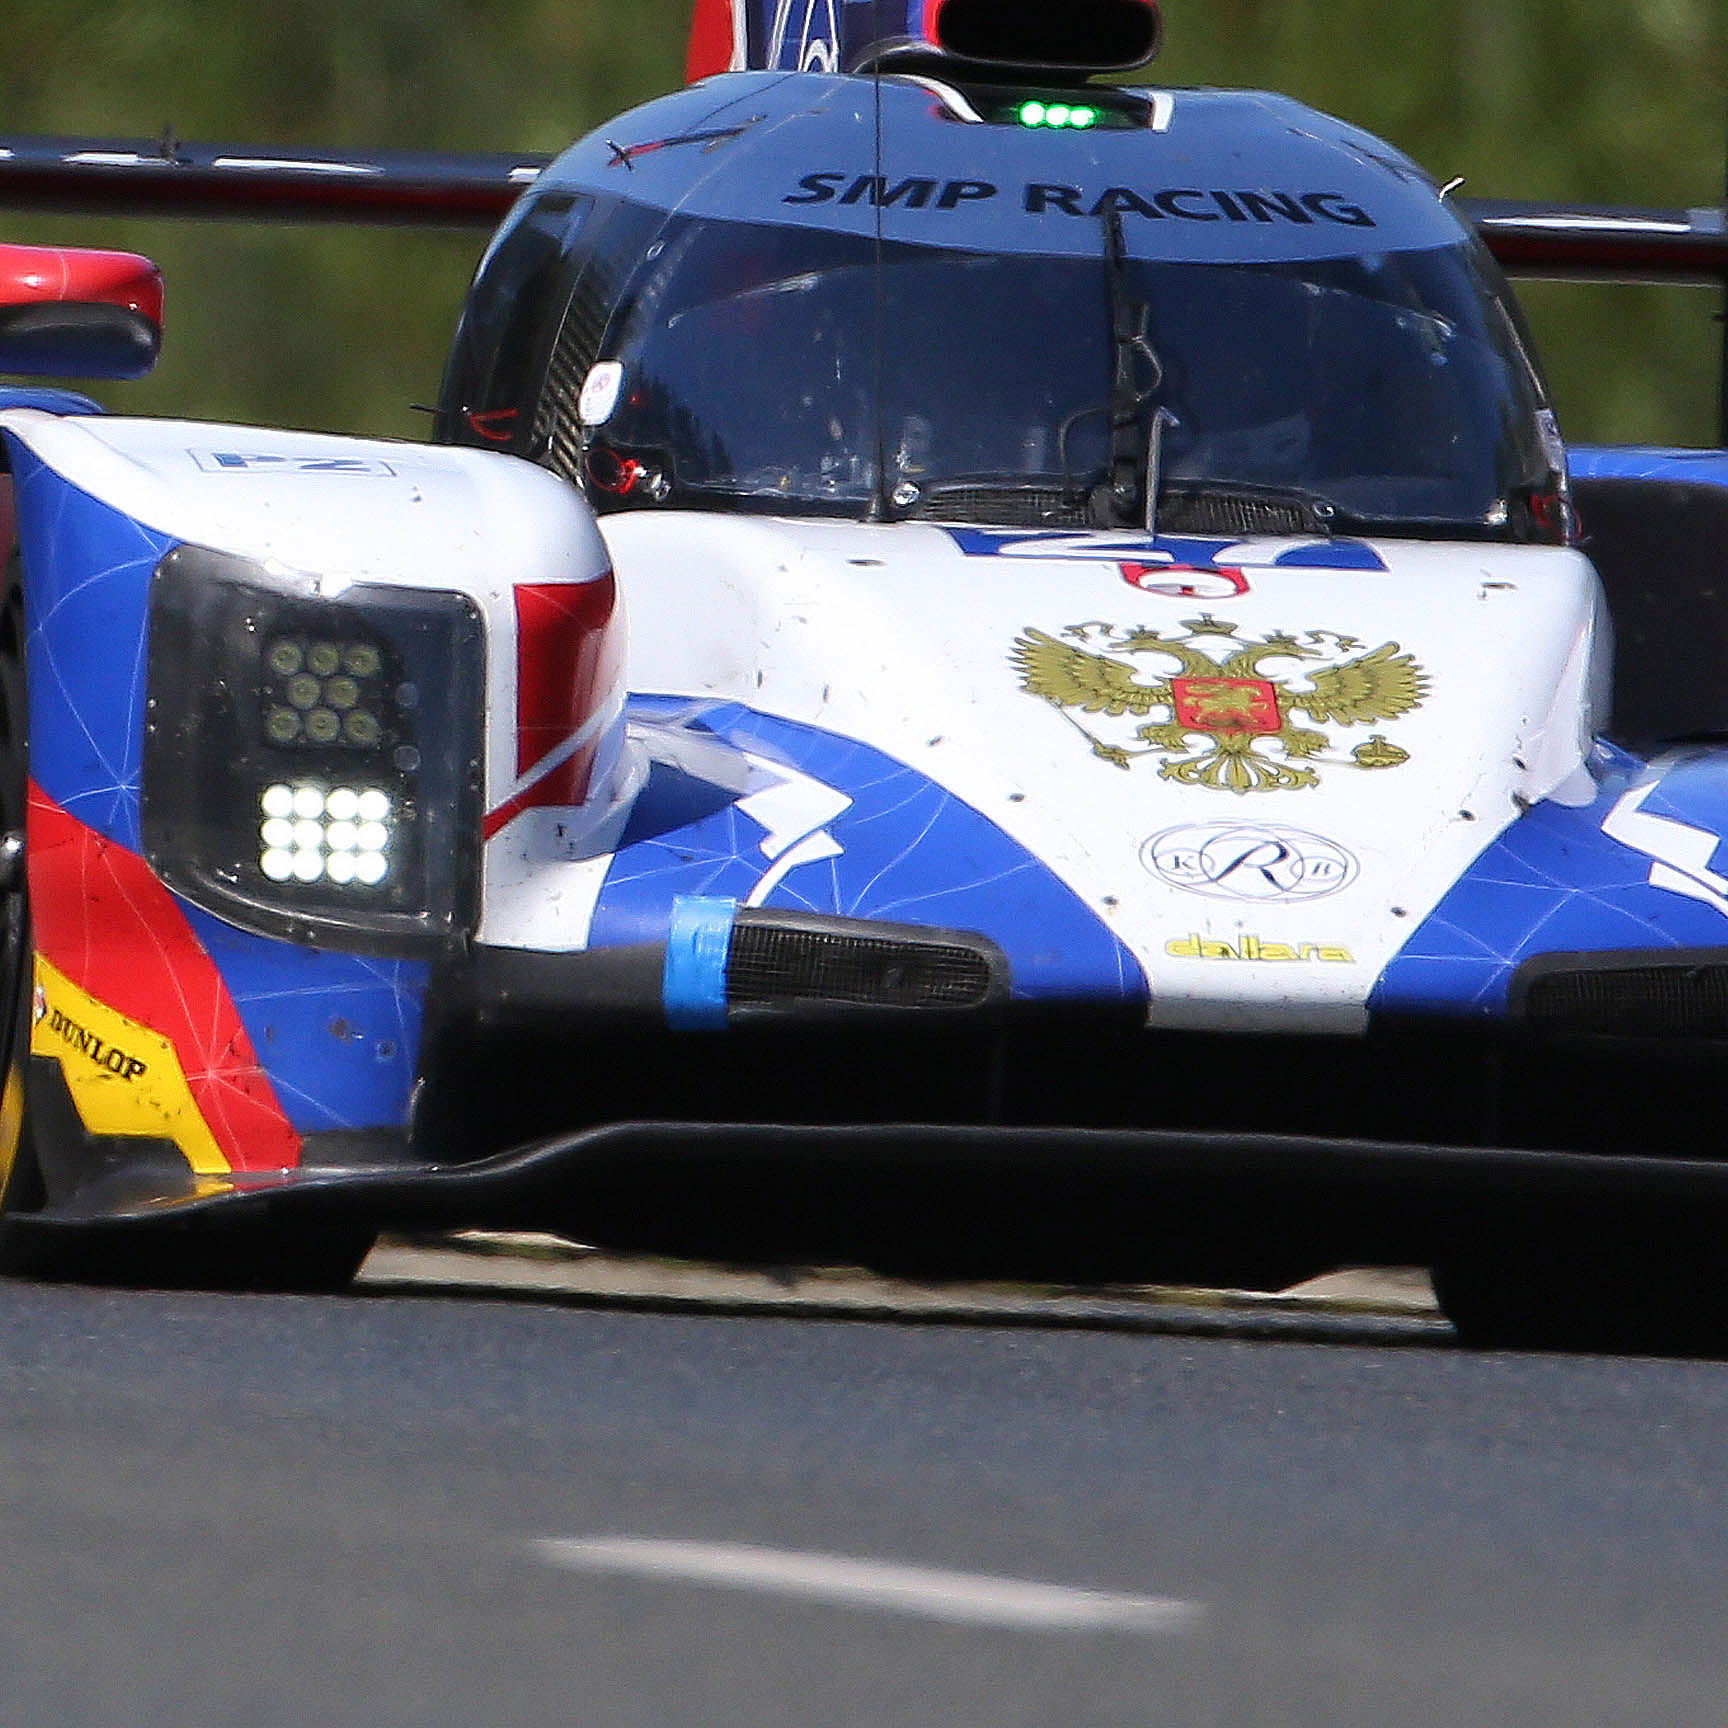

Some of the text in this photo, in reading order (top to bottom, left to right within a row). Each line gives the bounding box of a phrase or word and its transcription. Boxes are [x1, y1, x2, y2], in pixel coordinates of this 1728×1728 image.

[782, 173, 1376, 227] SMP RACING
[1165, 933, 1356, 963] dallara
[50, 1009, 146, 1080] DUNLOP
